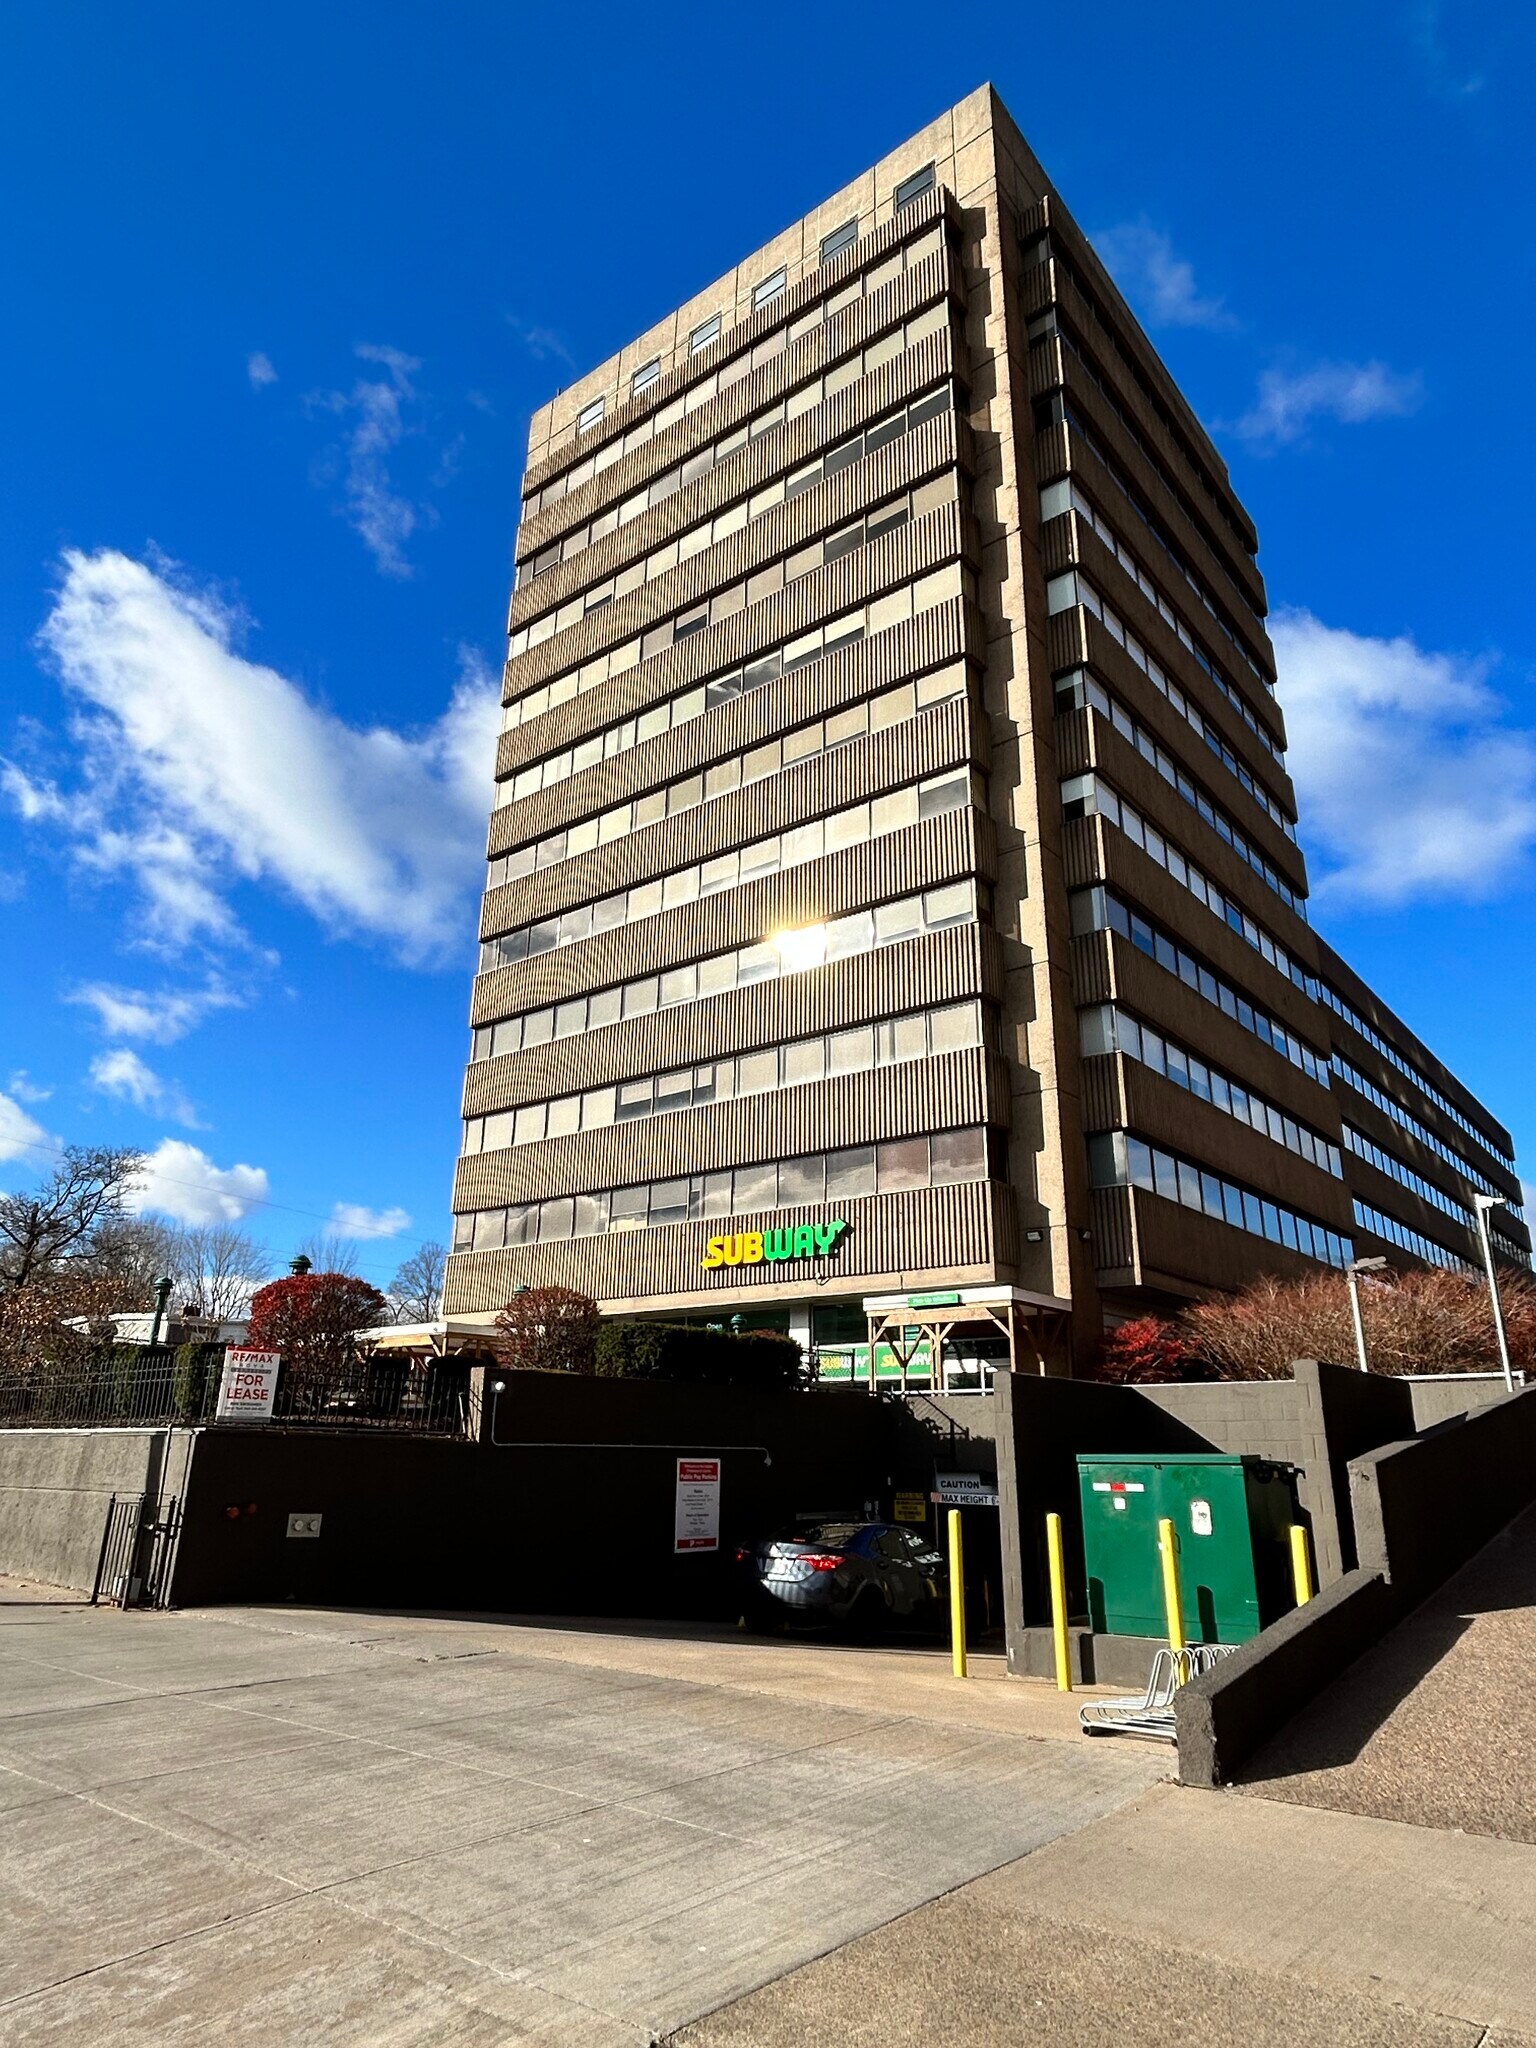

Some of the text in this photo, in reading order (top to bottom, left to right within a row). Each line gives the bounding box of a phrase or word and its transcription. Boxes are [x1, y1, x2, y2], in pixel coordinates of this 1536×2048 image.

[701, 1218, 846, 1270] SUBWAY
[231, 1352, 275, 1364] RE/MAX
[235, 1373, 264, 1387] FOR
[226, 1387, 269, 1401] LEASE
[940, 1480, 980, 1489] CAUTION
[941, 1494, 958, 1503] MAX
[960, 1495, 988, 1504] HEIGHT
